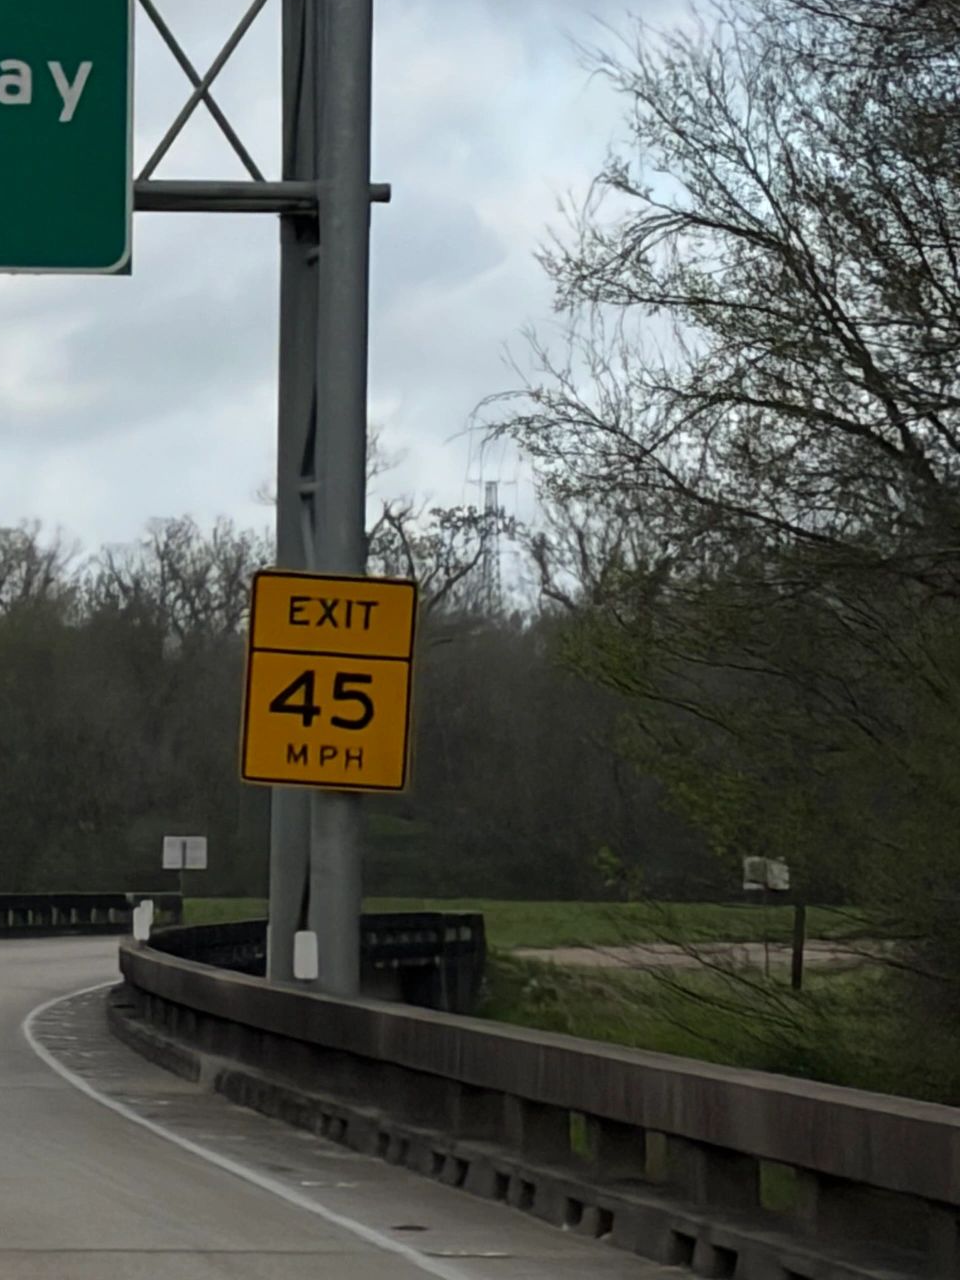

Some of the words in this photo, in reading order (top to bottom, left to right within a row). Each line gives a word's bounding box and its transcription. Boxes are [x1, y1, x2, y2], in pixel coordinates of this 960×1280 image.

[288, 595, 379, 630] EXIT
[269, 670, 374, 730] 45
[287, 743, 364, 769] MPH
